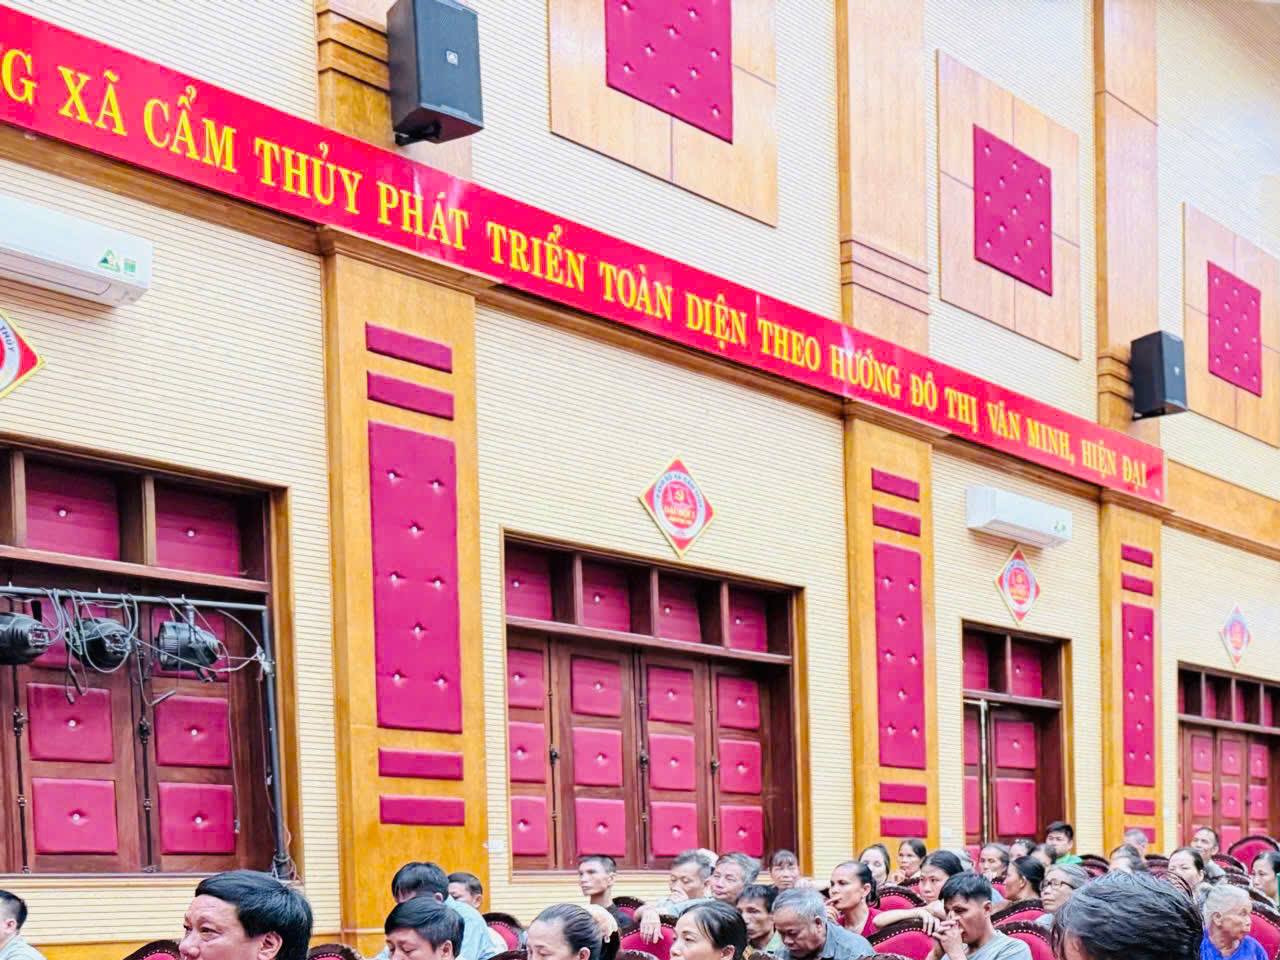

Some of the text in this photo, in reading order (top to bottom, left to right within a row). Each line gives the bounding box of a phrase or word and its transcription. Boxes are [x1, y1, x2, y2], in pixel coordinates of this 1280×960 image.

[0, 44, 1148, 492] G XÃ CẨM THỦY PHÁT TRIỂN TOÀN DIỆN THEO HƯỚNG ĐÔ THỊ VĂN MINH, HIỆN ĐẠI
